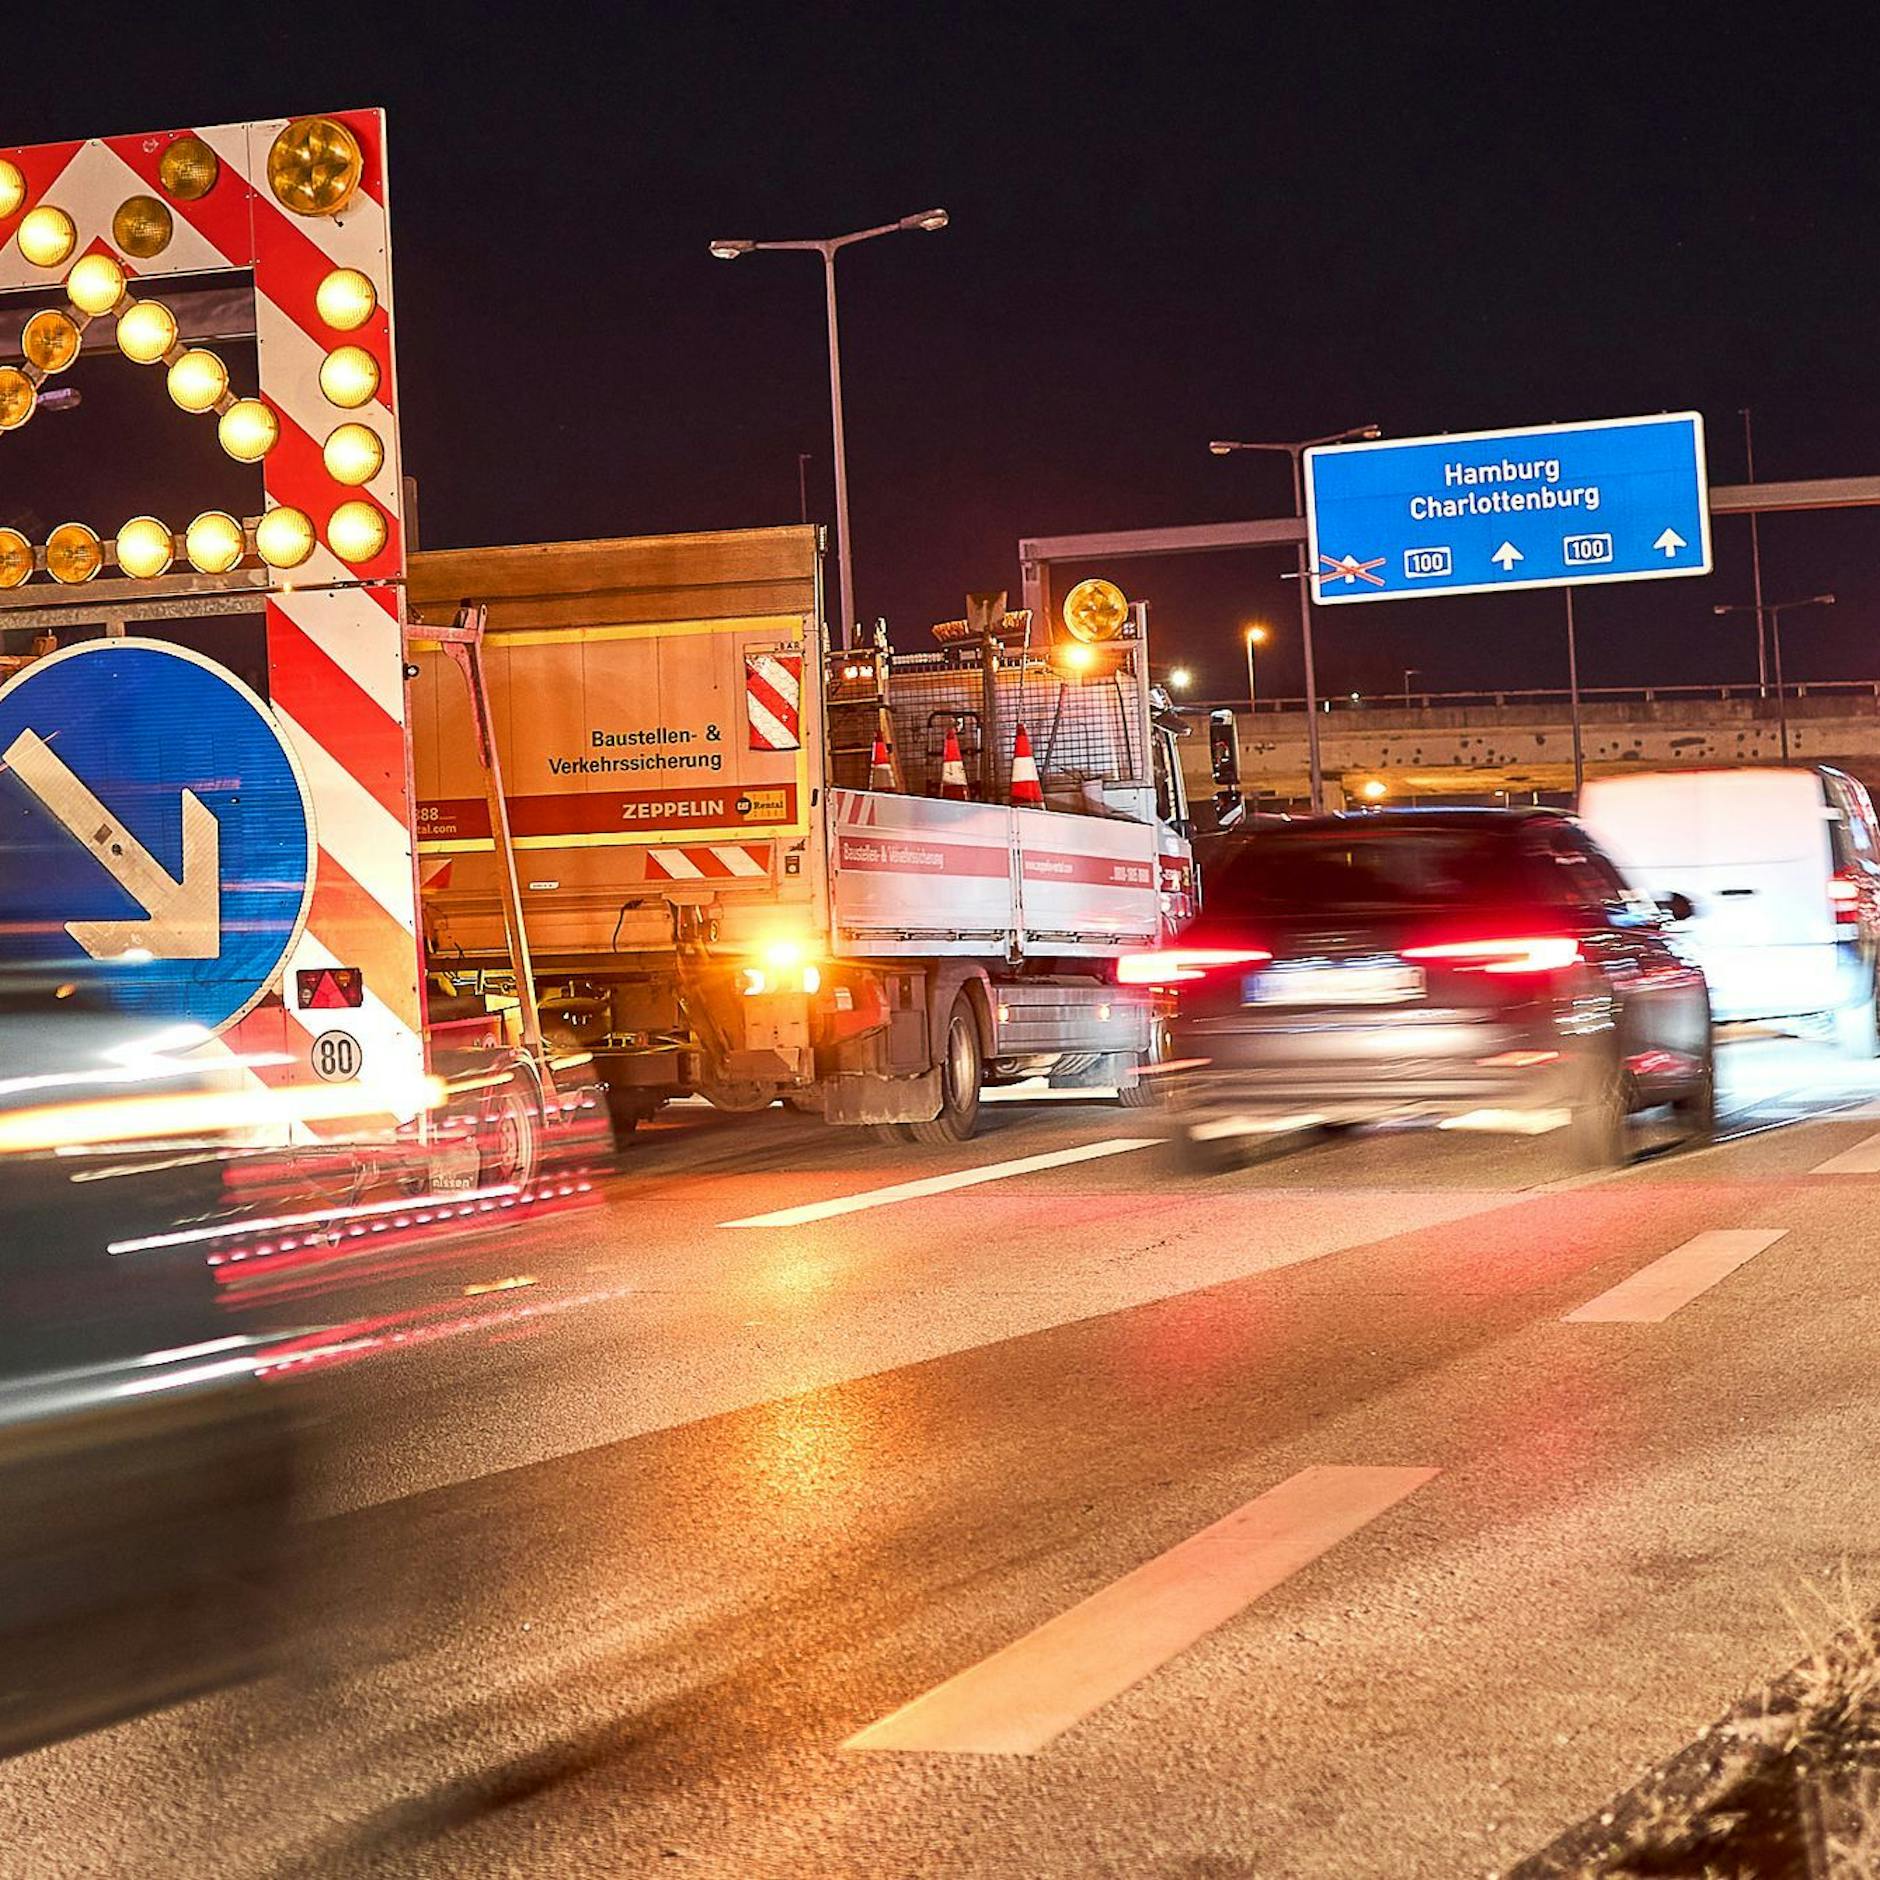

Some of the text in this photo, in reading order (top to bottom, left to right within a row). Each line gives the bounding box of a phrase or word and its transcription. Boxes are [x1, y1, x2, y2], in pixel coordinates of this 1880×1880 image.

[1444, 459, 1560, 487] Hamburg
[1410, 486, 1600, 520] Charlottenburg
[1412, 539, 1604, 573] 100 100
[591, 724, 721, 747] Baustellen- &
[547, 754, 722, 775] Verkehrssicherung
[622, 799, 724, 819] ZEPPELIN
[321, 1039, 352, 1074] 80
[432, 1173, 471, 1188] nissen
